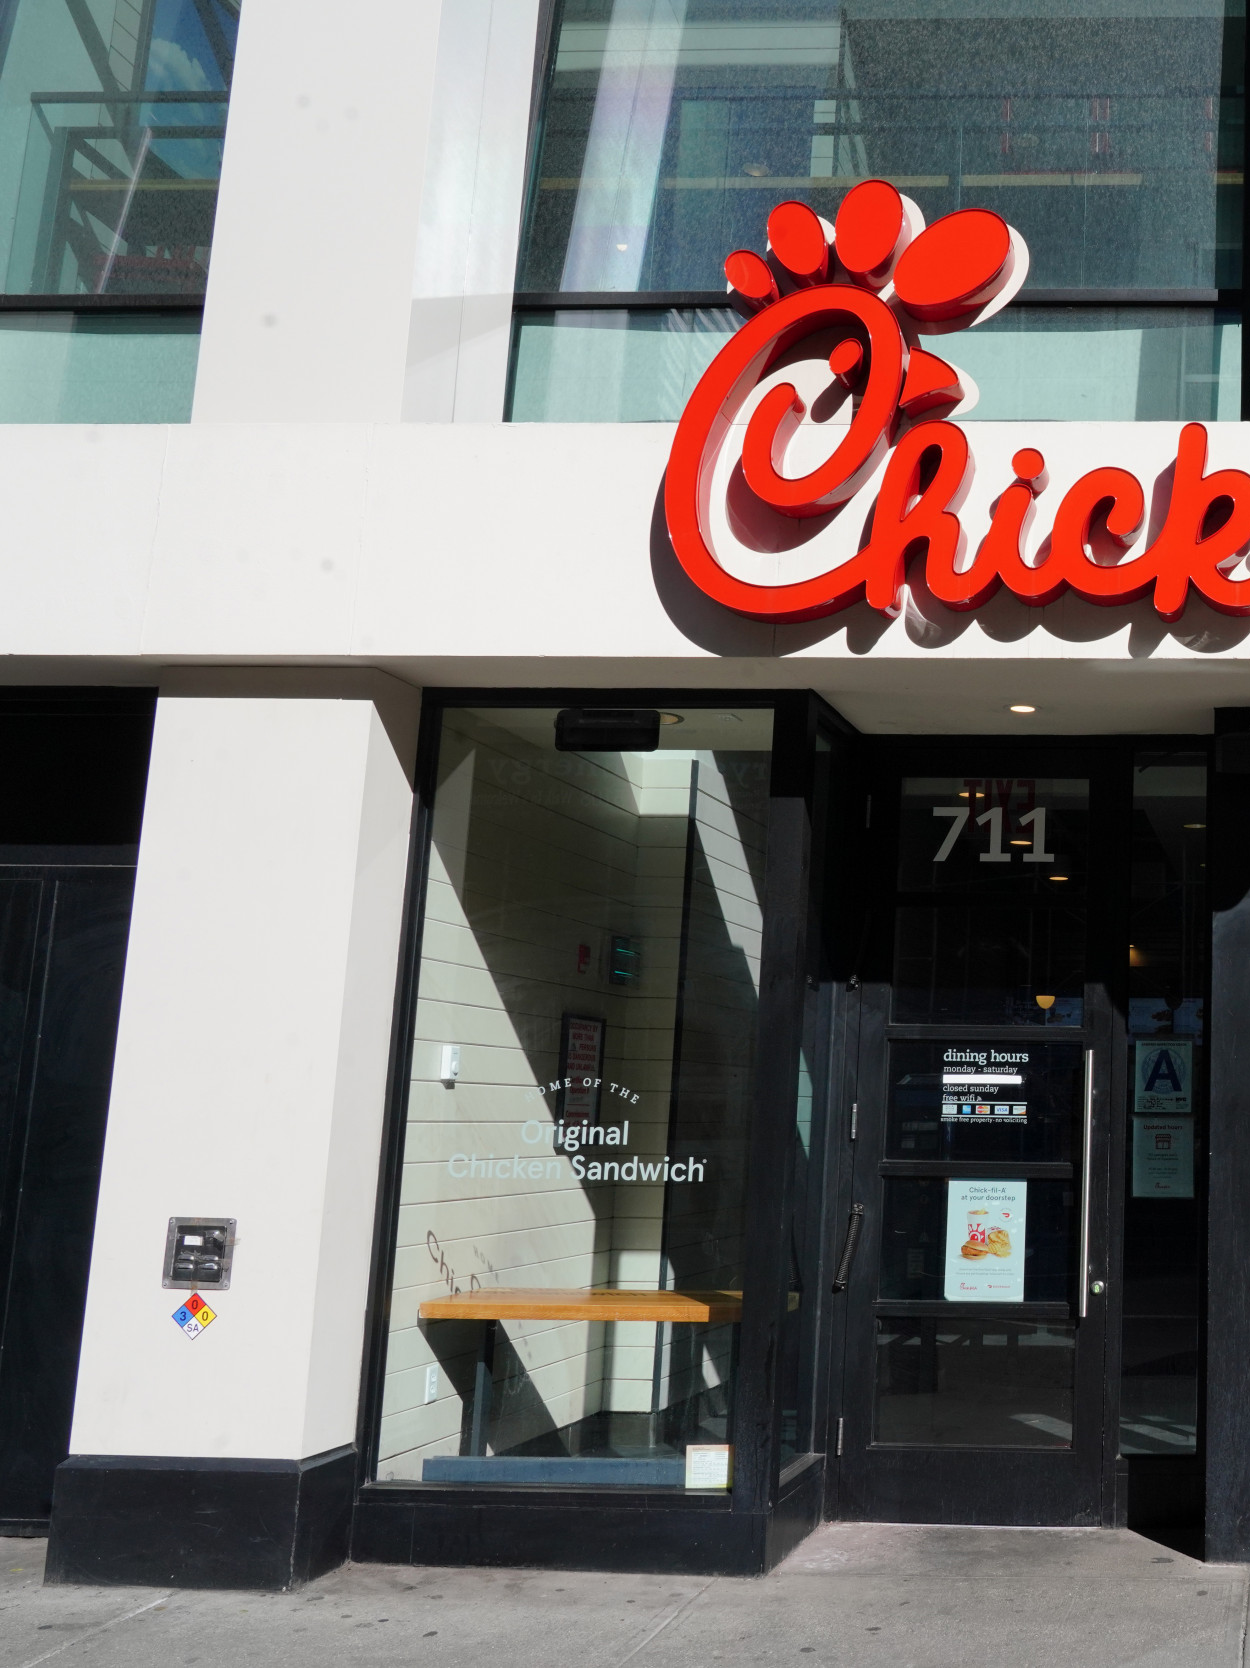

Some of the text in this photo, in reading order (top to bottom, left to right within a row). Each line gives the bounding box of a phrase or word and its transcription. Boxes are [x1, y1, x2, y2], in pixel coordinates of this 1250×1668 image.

[932, 806, 1055, 863] 711
[943, 1049, 1029, 1065] dining hours
[943, 1065, 977, 1074] monday
[983, 1066, 1018, 1075] saturday
[1144, 1049, 1183, 1092] A
[524, 1077, 572, 1103] HOME
[582, 1077, 602, 1088] OF
[610, 1082, 641, 1105] THE
[942, 1084, 999, 1094] closed sunday
[942, 1094, 975, 1102] free wifi
[521, 1119, 629, 1152] Original
[447, 1153, 705, 1183] Chicken Sandwich
[191, 1299, 198, 1309] 0
[179, 1311, 208, 1321] 3 0
